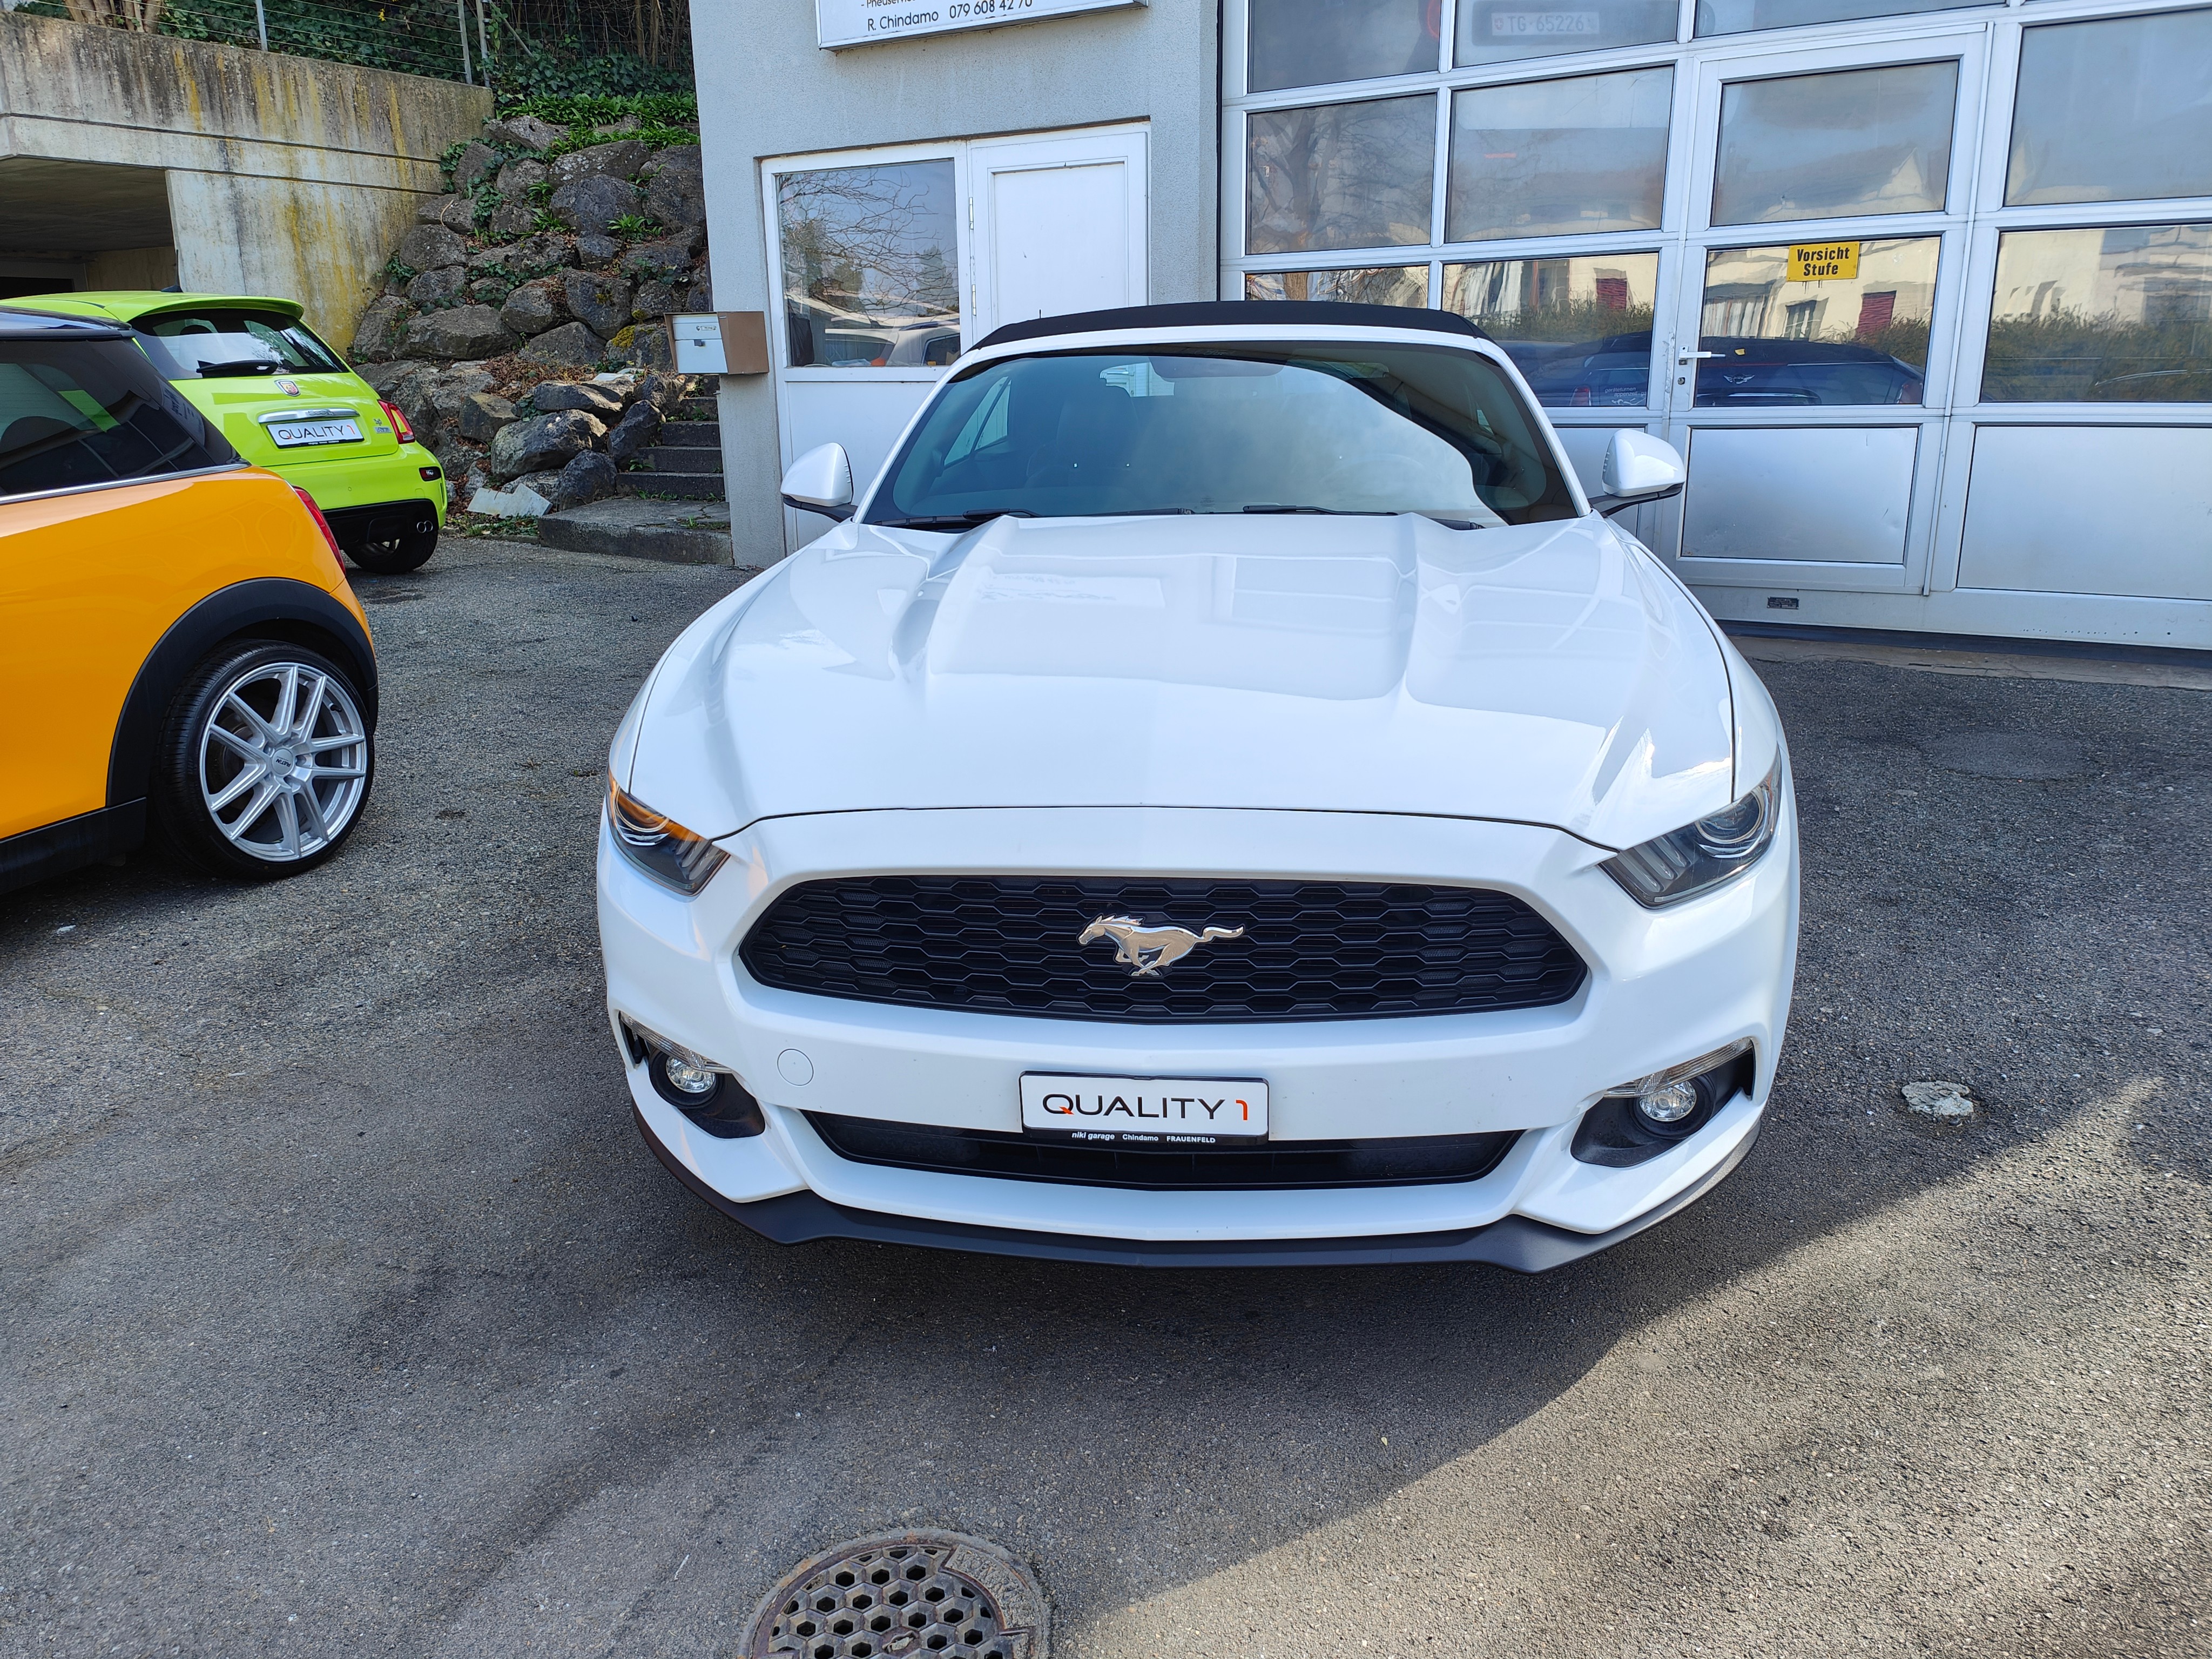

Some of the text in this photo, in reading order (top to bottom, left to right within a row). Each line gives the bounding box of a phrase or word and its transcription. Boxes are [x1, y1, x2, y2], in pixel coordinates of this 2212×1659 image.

[868, 18, 876, 31] R.
[880, 11, 939, 29] Chindamo
[949, 3, 970, 18] 079
[974, 0, 995, 15] 608
[1797, 247, 1850, 261] Vorsicht
[1803, 262, 1838, 276] Stufe
[278, 425, 355, 440] QUALITY 1
[1042, 1094, 1248, 1121] QUALITY 1
[1122, 1134, 1159, 1142] Chindamo
